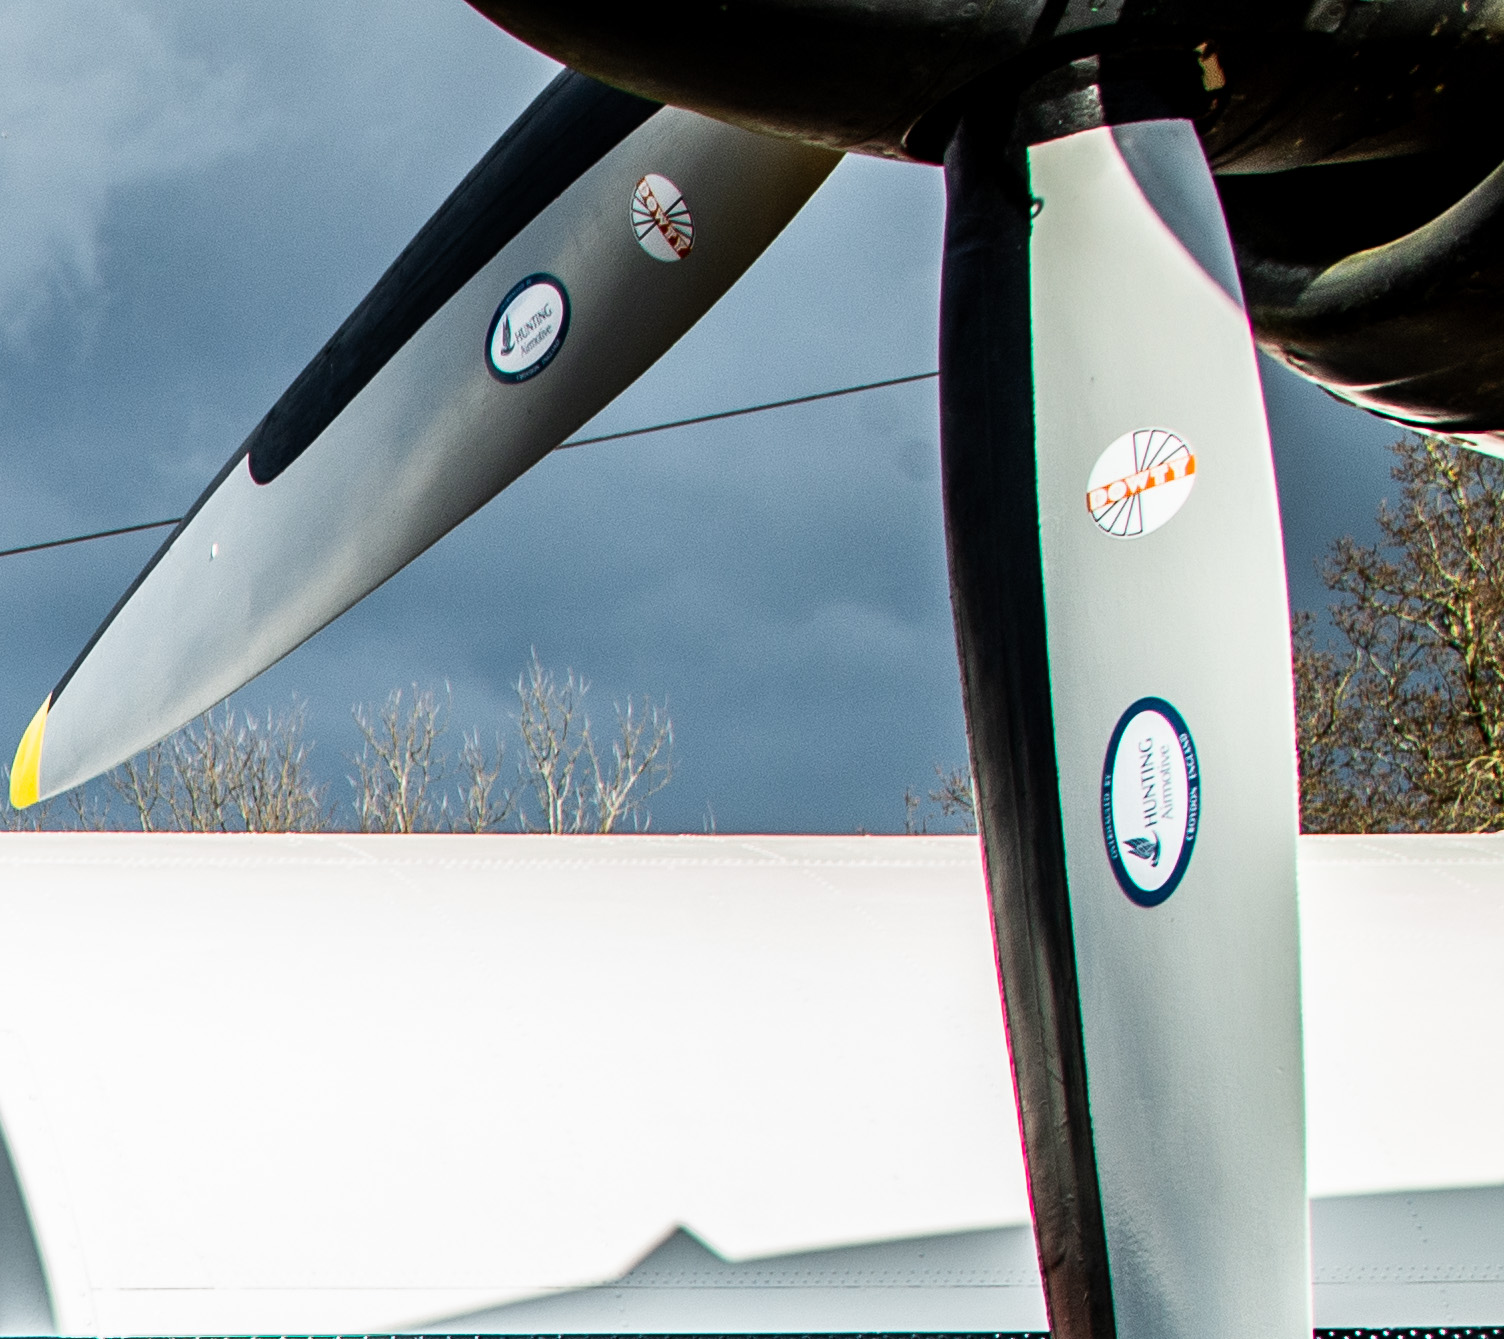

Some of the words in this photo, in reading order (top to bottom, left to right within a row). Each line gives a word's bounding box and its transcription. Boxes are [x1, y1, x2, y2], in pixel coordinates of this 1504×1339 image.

[637, 181, 691, 252] DOWTY
[514, 303, 552, 343] HUNTING
[1089, 456, 1189, 511] DOWTY
[1138, 737, 1157, 828] HUNTING
[1160, 744, 1173, 819] Airmotive
[1179, 732, 1197, 780] ENGLAND
[1186, 786, 1198, 841] CROYDON
